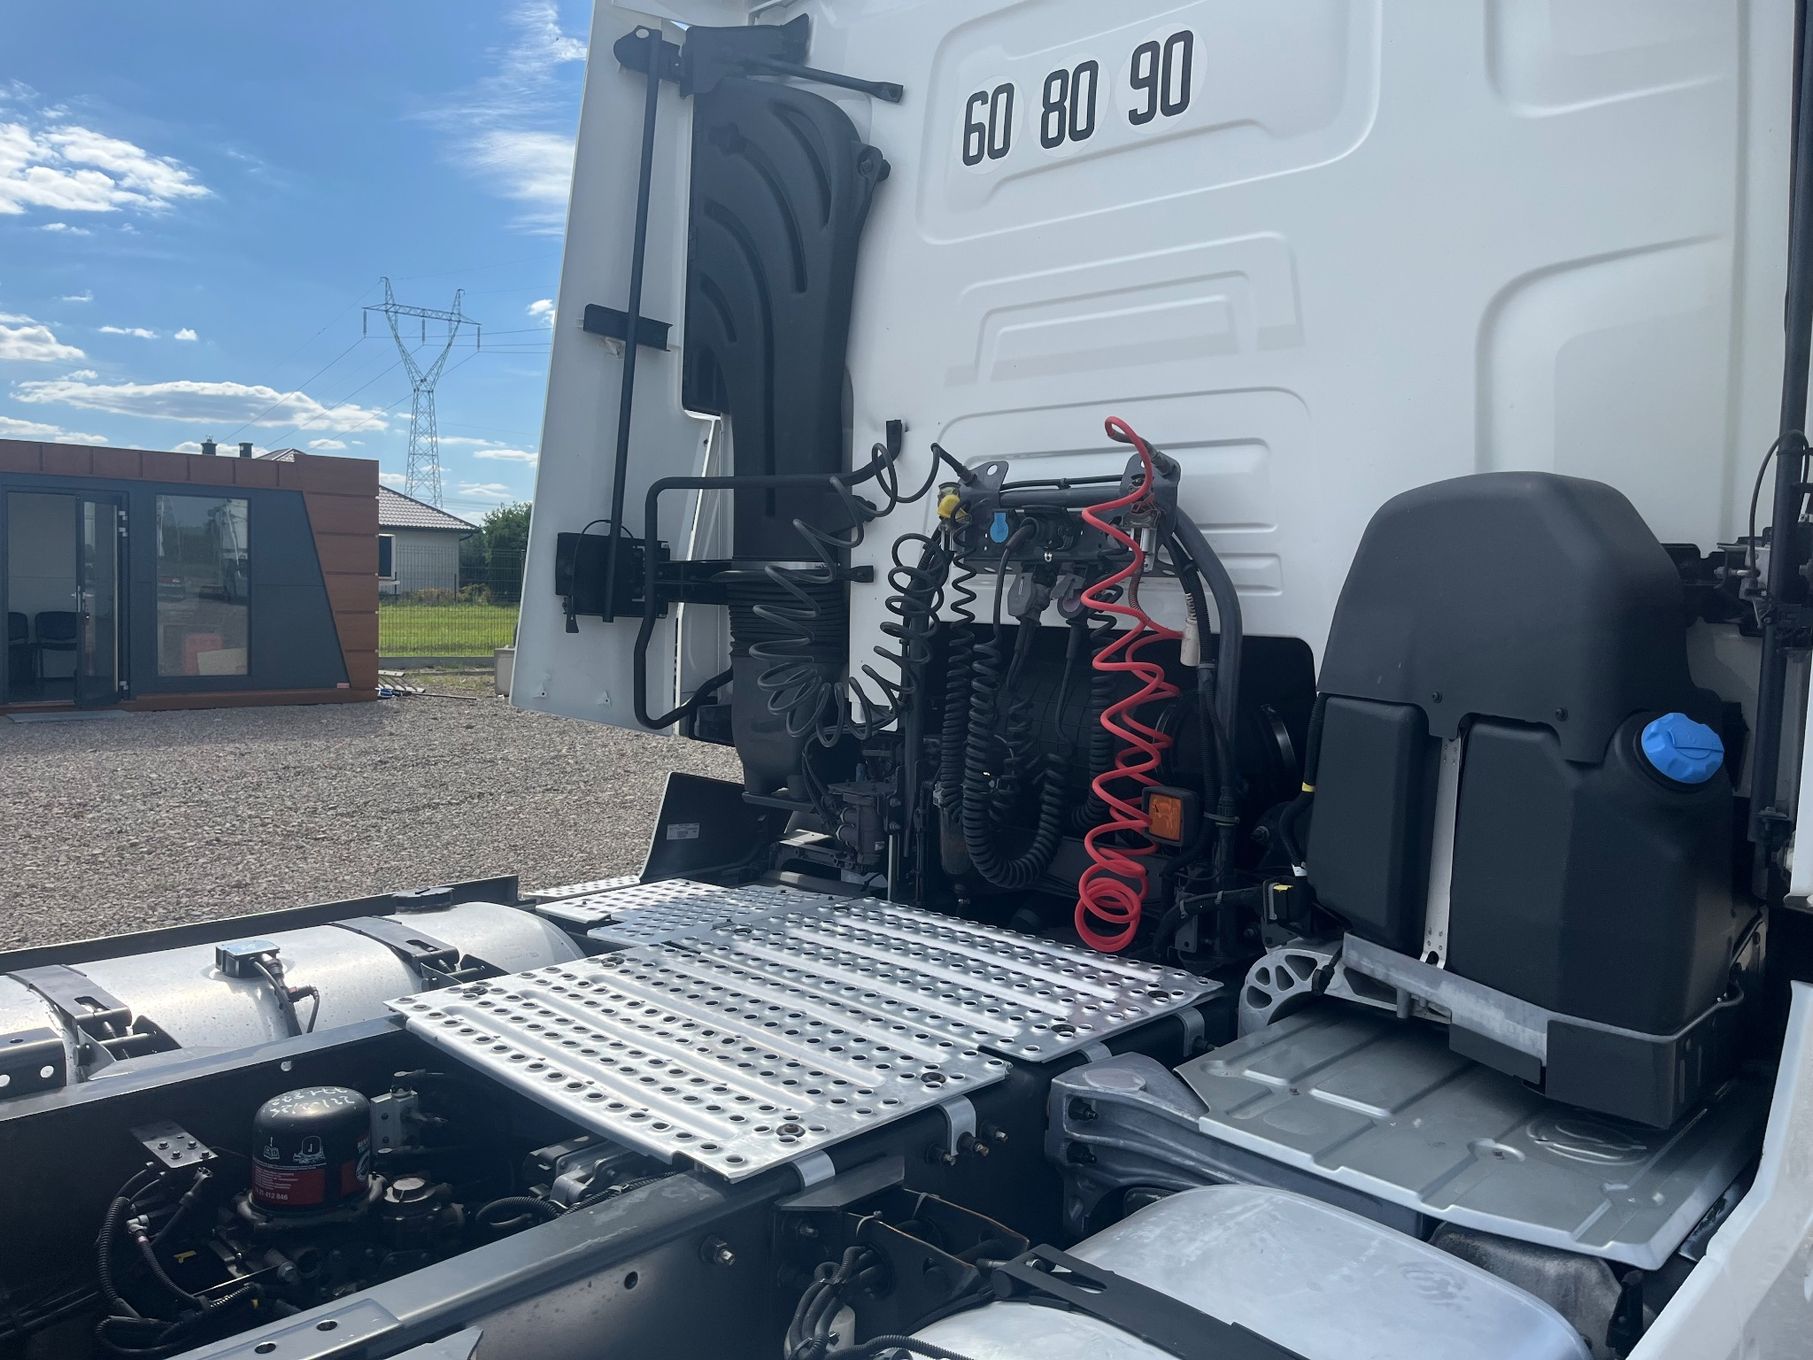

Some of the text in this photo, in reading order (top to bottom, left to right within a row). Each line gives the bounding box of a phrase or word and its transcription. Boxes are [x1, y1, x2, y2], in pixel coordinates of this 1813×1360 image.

[962, 29, 1194, 167] 60 80 90
